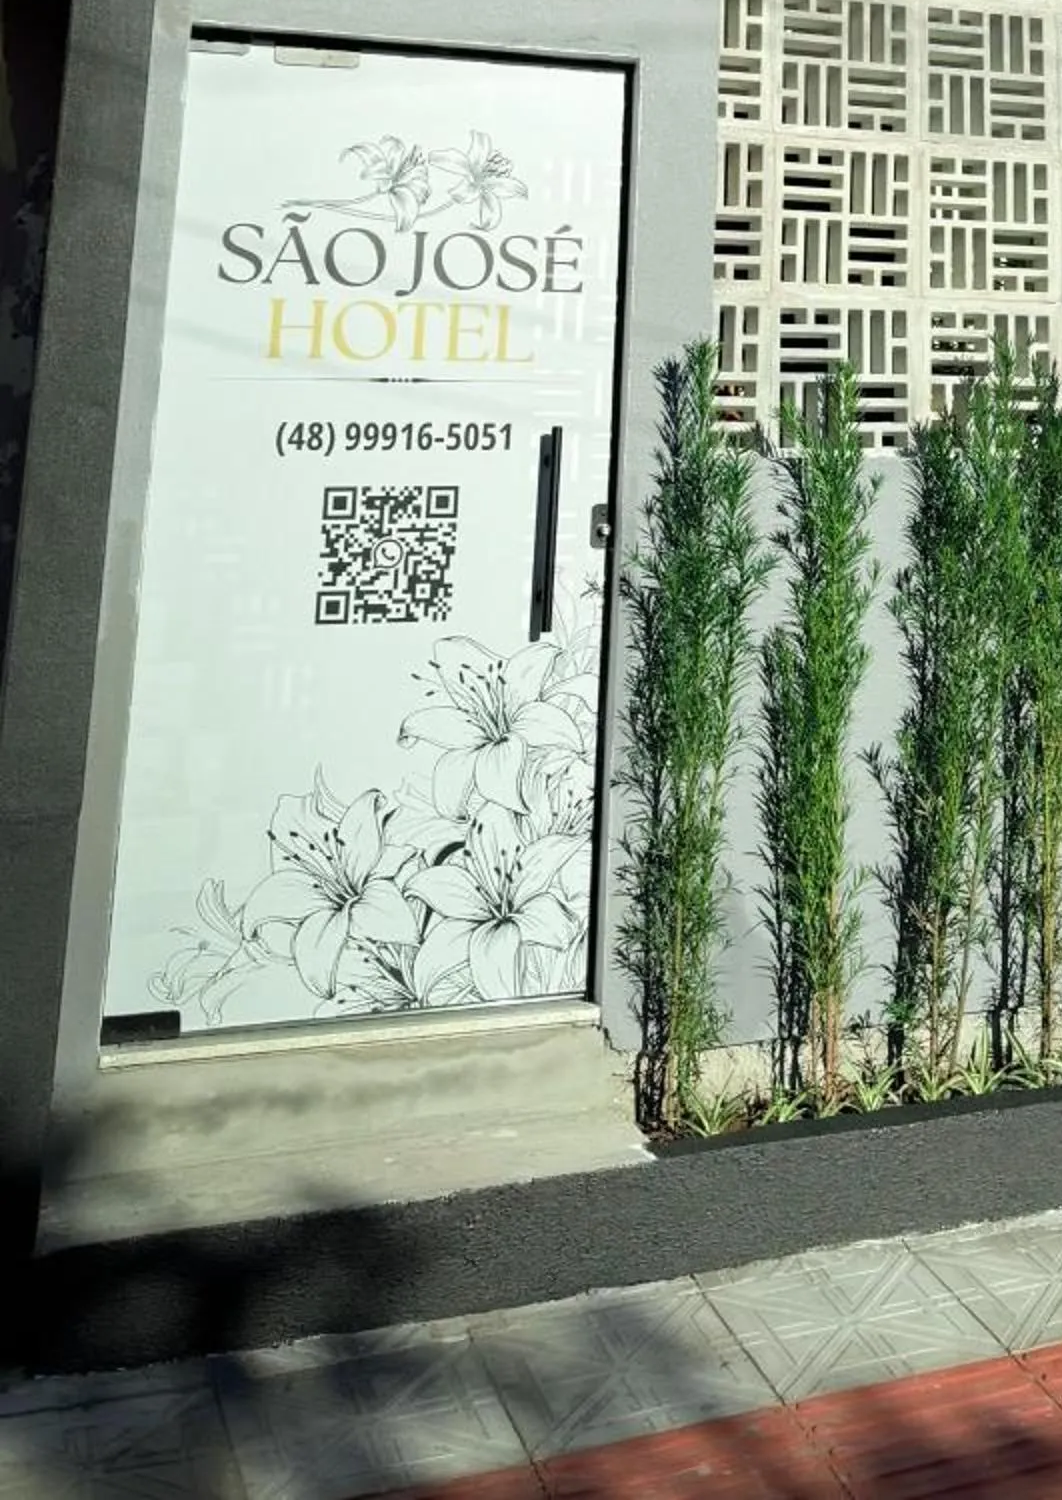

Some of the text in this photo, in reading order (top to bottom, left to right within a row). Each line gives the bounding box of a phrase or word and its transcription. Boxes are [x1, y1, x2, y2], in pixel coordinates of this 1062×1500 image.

[217, 212, 584, 297] SÃO JOSÉ
[264, 297, 535, 364] HOTEL
[275, 421, 513, 457] (48) 99916-5051
